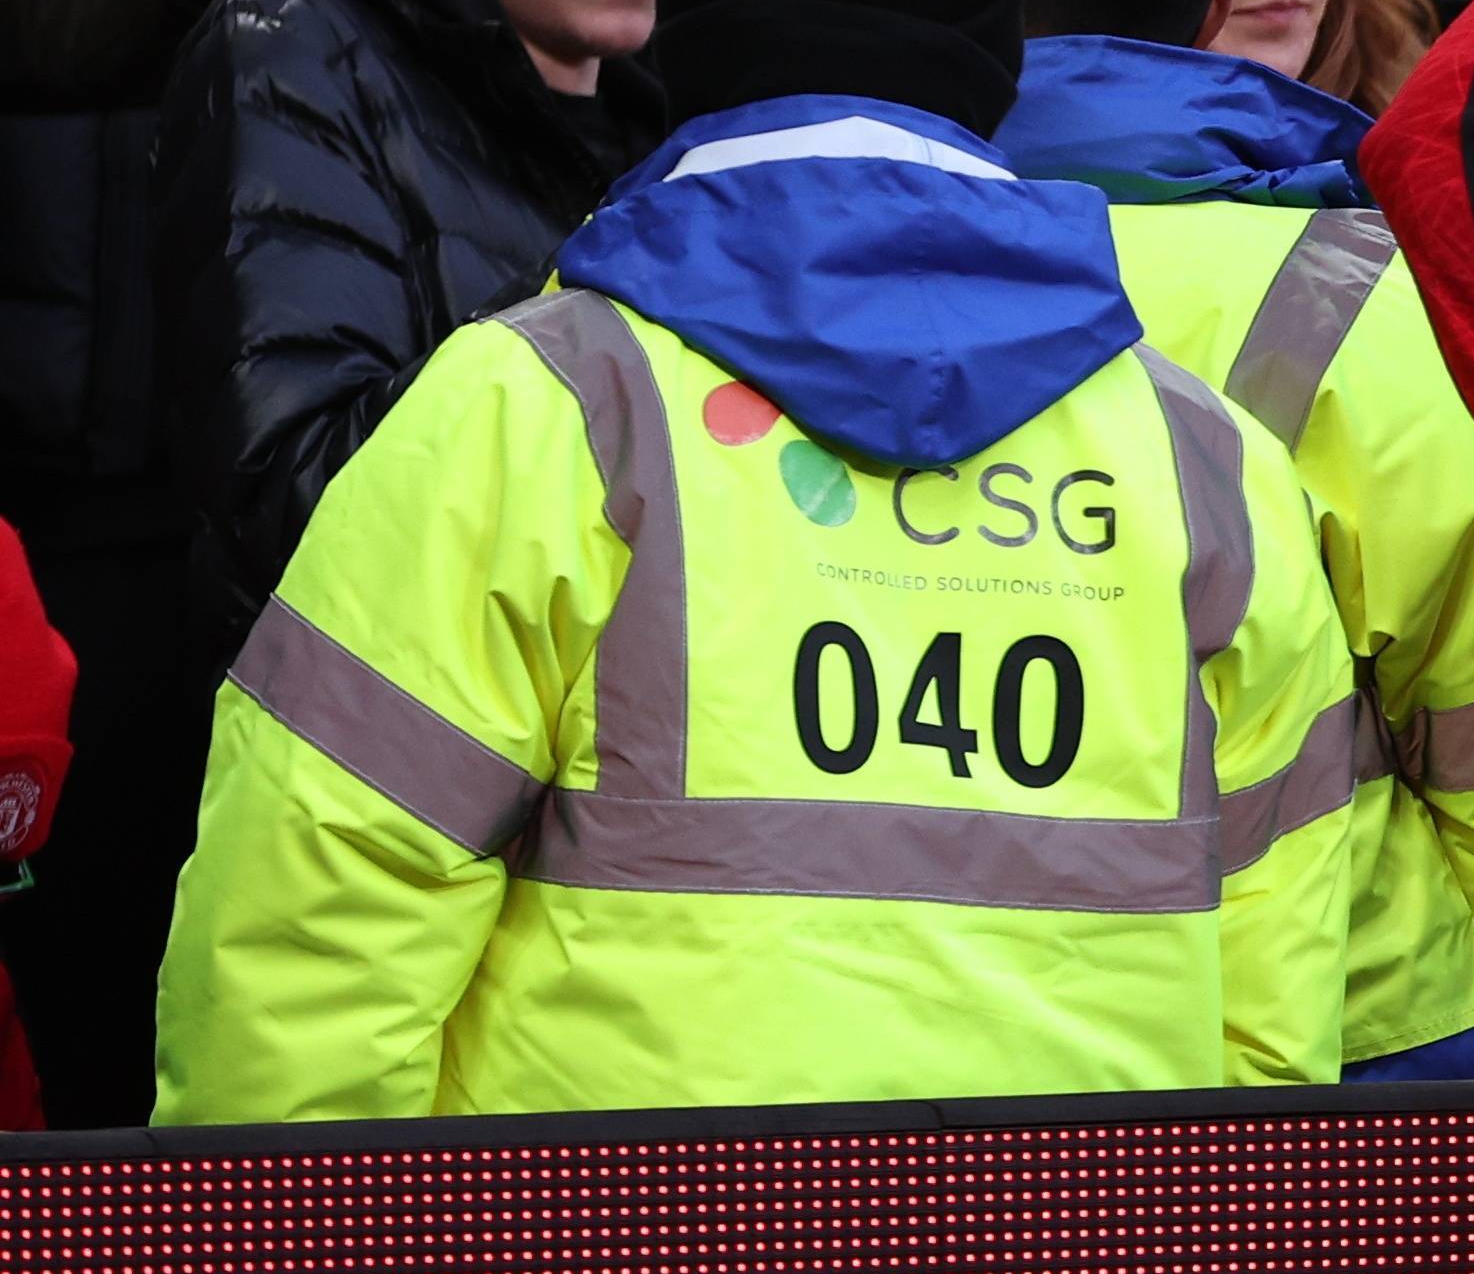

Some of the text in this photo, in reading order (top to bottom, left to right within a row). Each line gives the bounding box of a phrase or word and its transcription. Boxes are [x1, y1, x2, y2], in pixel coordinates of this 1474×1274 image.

[892, 462, 1116, 555] CSG
[816, 563, 1126, 602] CONTROLLED SOLUTIONS GROUP
[793, 620, 1085, 789] 040
